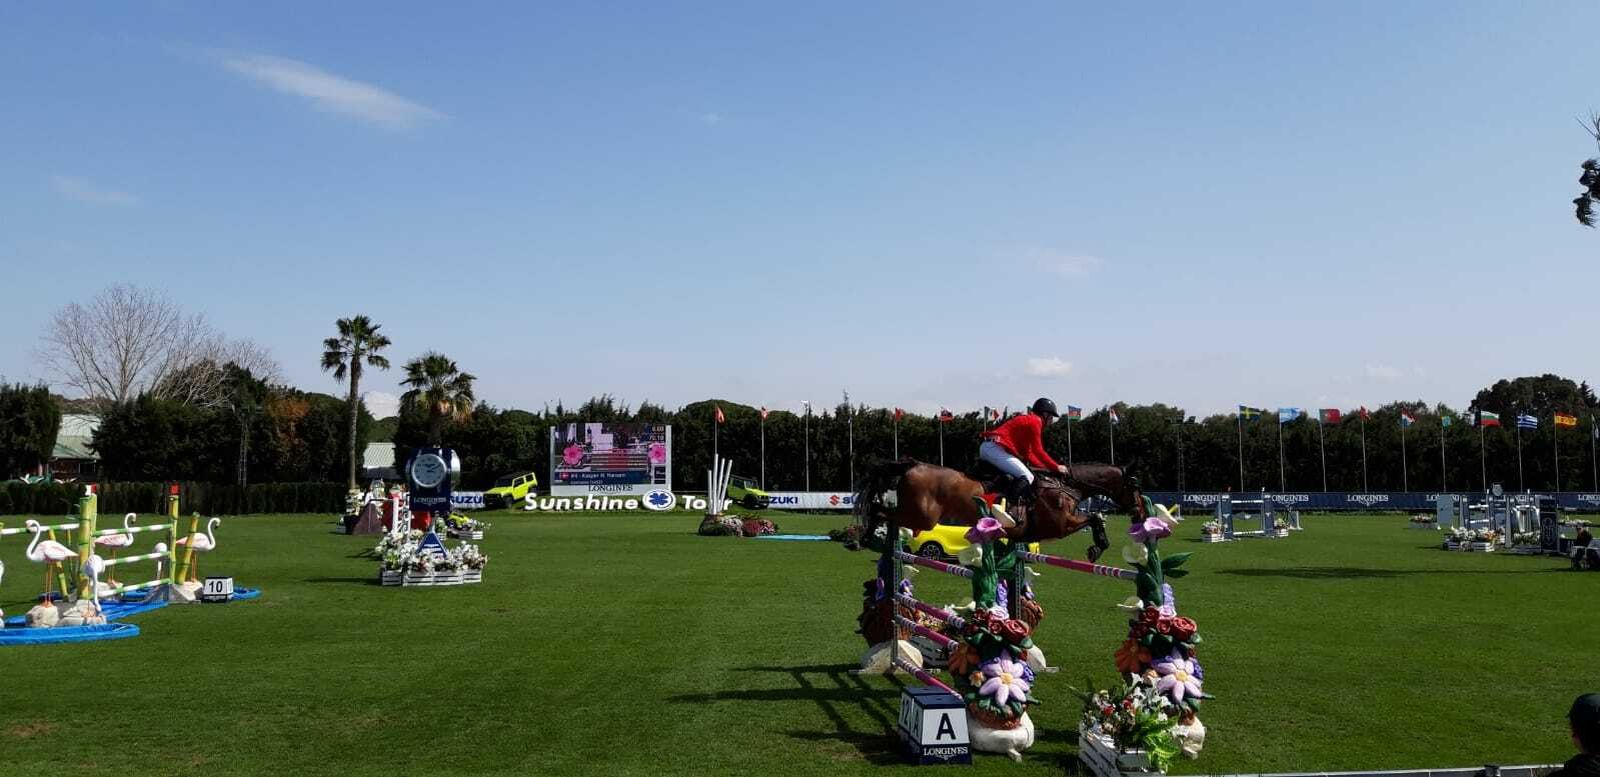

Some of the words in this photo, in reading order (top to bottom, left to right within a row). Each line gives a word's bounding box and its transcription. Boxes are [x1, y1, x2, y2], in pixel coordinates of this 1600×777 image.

[589, 484, 633, 492] LONGINES
[450, 495, 483, 504] UZU
[524, 493, 639, 510] Sunshine
[682, 494, 733, 511] Tor
[769, 496, 799, 505] ZUKI
[1347, 494, 1388, 502] LONGINES
[208, 580, 223, 593] 10
[936, 713, 956, 740] A
[924, 747, 968, 756] LONGINES
